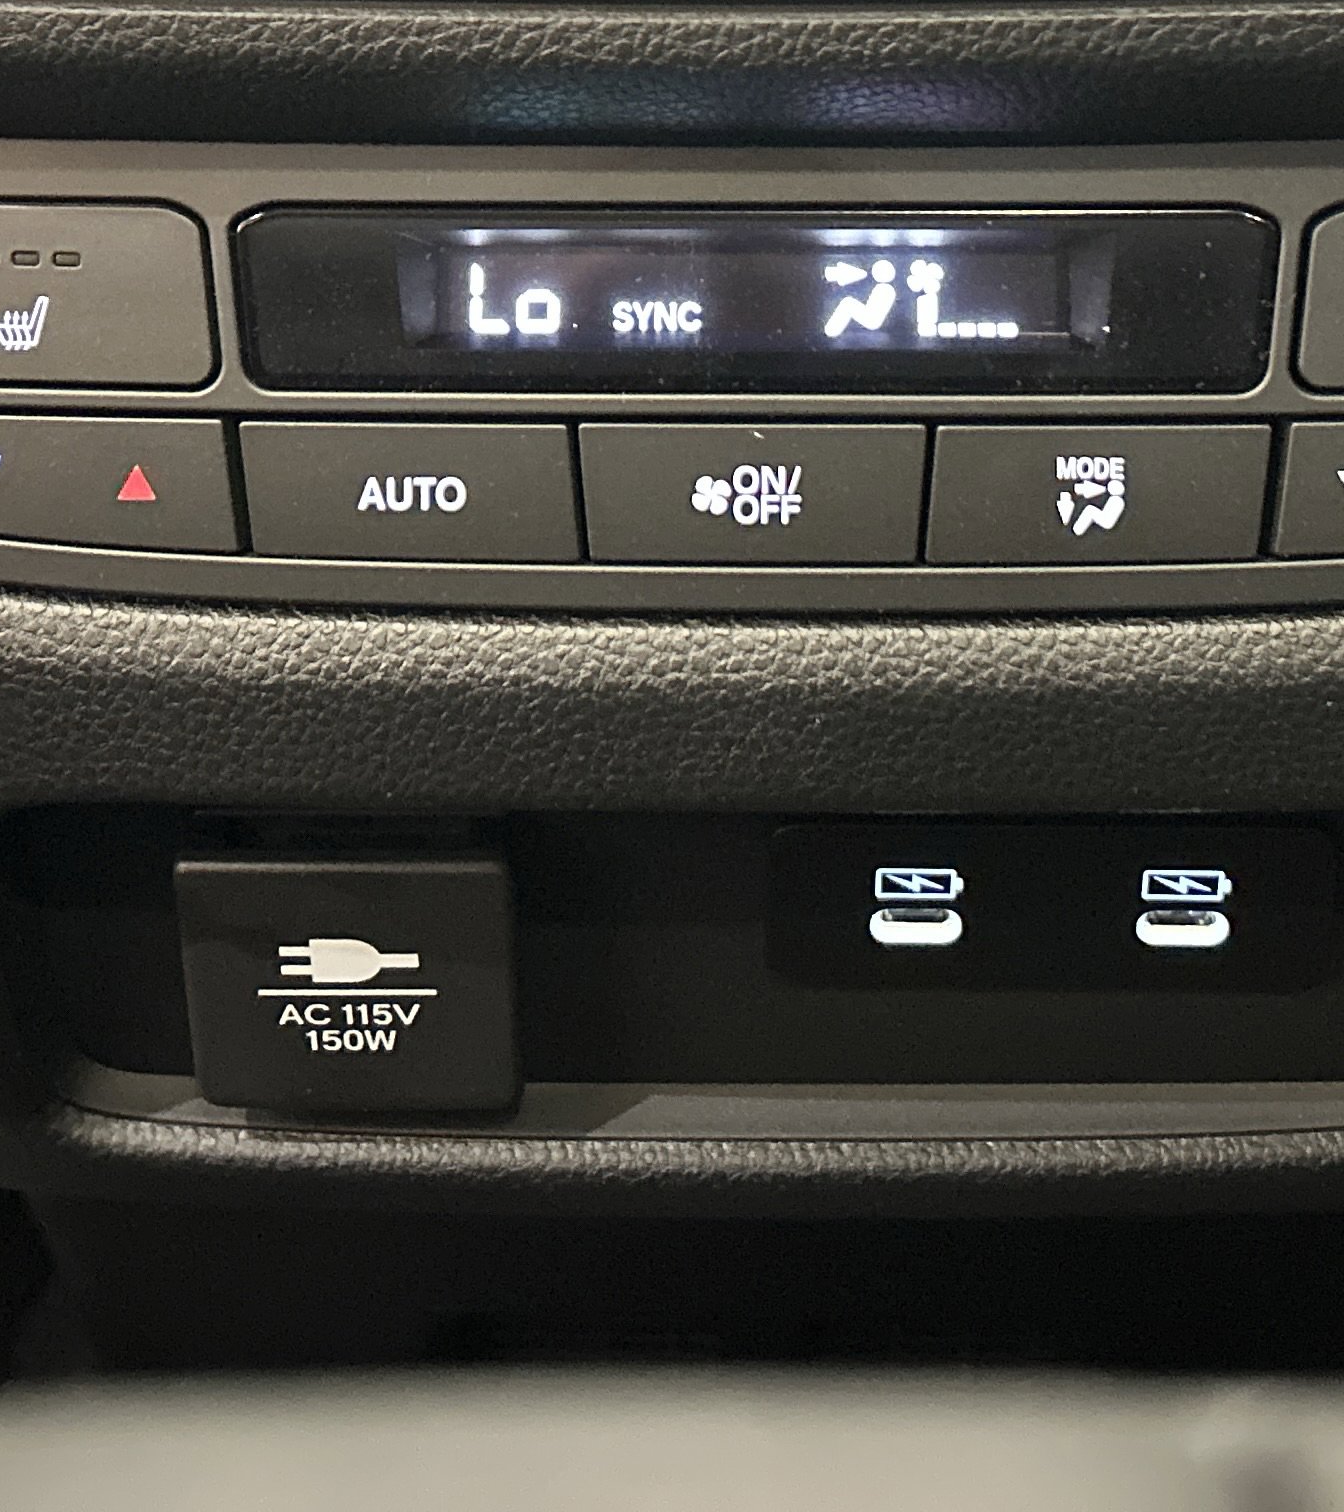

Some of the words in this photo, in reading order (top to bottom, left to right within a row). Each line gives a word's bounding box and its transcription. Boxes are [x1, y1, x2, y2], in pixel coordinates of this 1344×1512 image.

[469, 262, 561, 335] Lo
[612, 300, 703, 332] SYNC
[731, 464, 802, 495] ON/
[1056, 456, 1125, 481] MODE
[358, 476, 467, 512] AUTO
[731, 494, 802, 525] OFF
[278, 1003, 332, 1026] AC
[341, 1003, 421, 1026] 115V
[305, 1029, 397, 1052] 150W
